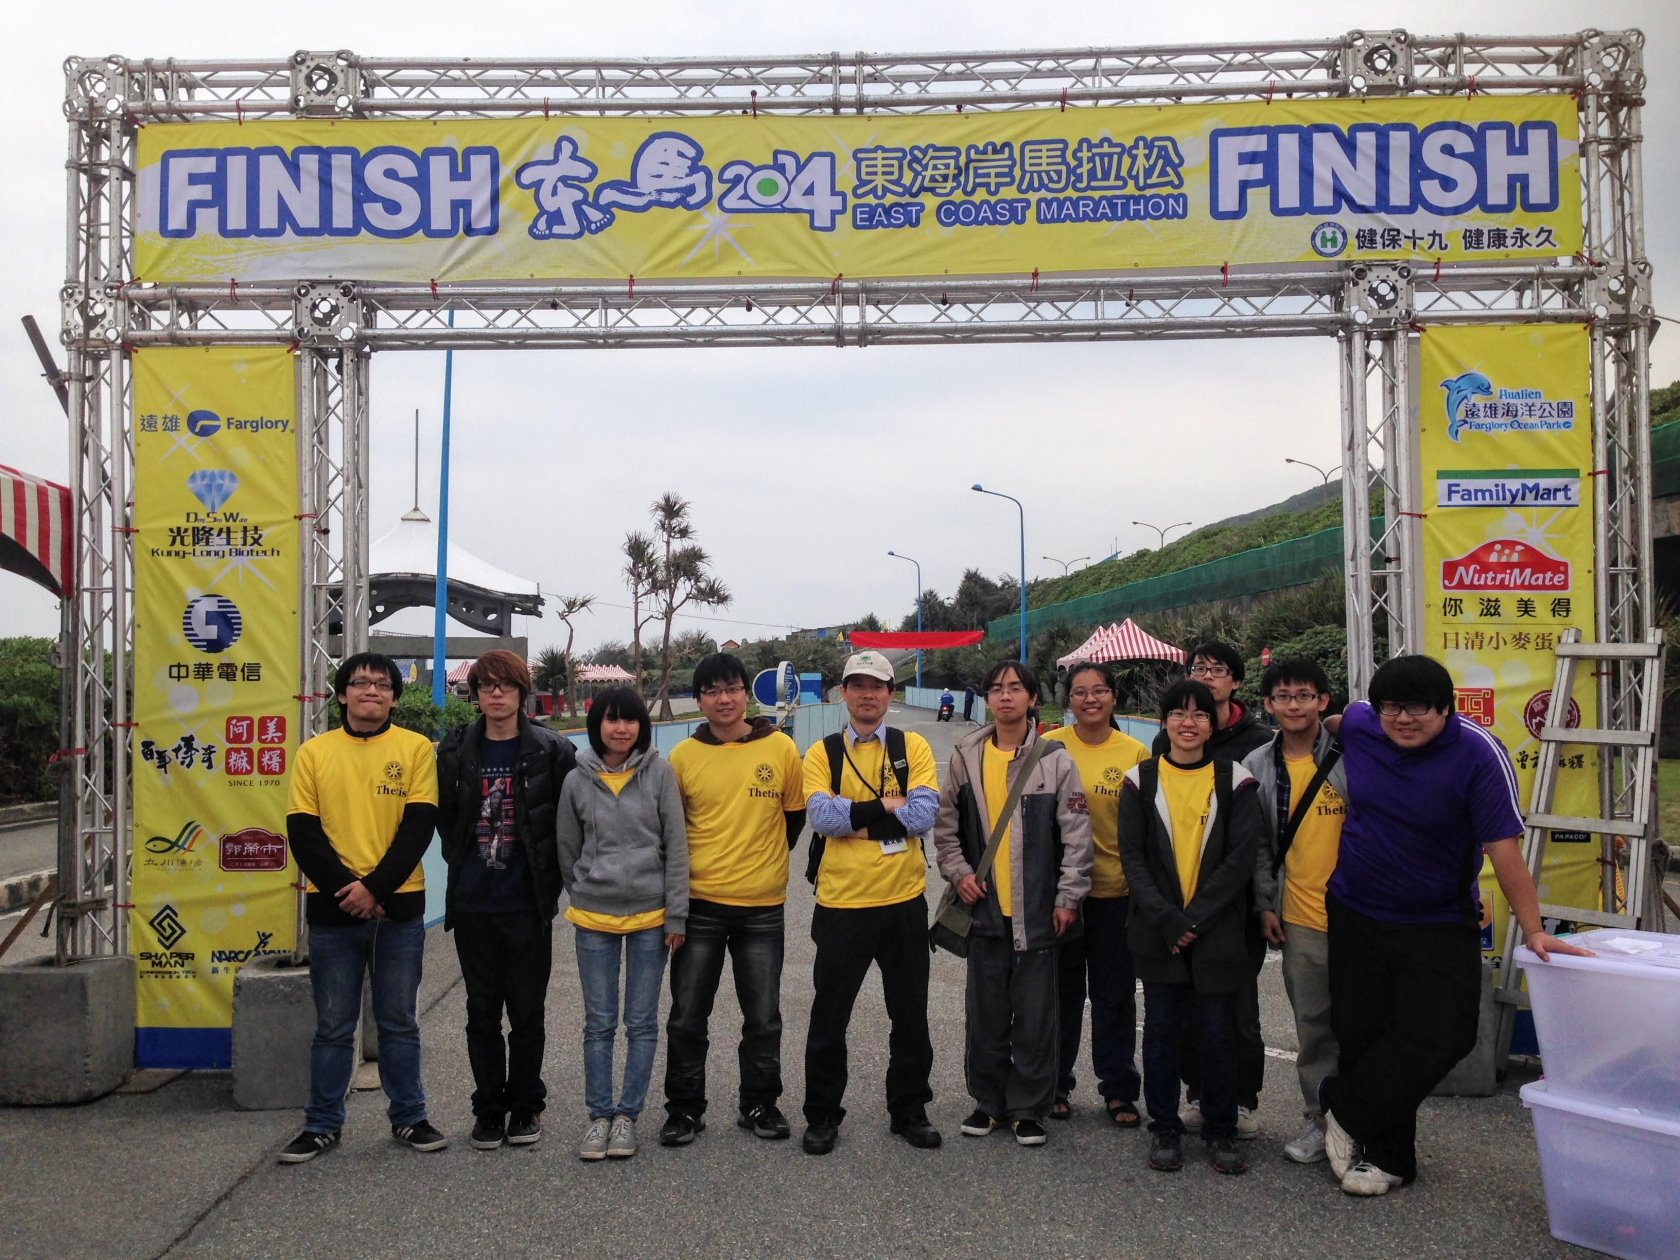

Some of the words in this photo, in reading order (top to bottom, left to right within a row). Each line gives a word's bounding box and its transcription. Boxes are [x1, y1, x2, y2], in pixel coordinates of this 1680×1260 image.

[854, 138, 1182, 196] 東海岸馬拉松
[1211, 121, 1557, 216] FINISH
[161, 146, 499, 238] FINISH
[854, 206, 922, 228] EAST
[938, 202, 1029, 224] COAST
[1038, 196, 1185, 221] MARATHON
[1355, 228, 1449, 251] 健保十九
[1462, 226, 1557, 250] 健康永久
[1499, 389, 1542, 400] Hualien
[1464, 401, 1573, 419] 遠雄海洋公園
[139, 414, 181, 433] 遠雄
[226, 416, 290, 432] Farglory
[1469, 420, 1509, 432] Farglory
[1510, 419, 1540, 431] Ocean
[1540, 419, 1562, 431] Park
[1447, 482, 1572, 505] FamilyMart
[168, 525, 264, 547] 光隆生技
[1444, 564, 1566, 587] NutriMate
[1442, 598, 1572, 618] 你滋美得
[1443, 631, 1561, 651] 日清小麥蛋
[168, 662, 262, 682] 中華電信
[227, 779, 254, 787] SINCE
[259, 779, 281, 787] 1970
[376, 784, 407, 798] Thetis
[748, 787, 780, 799] Thetis
[139, 952, 195, 961] SHAPER
[151, 960, 185, 968] MAN
